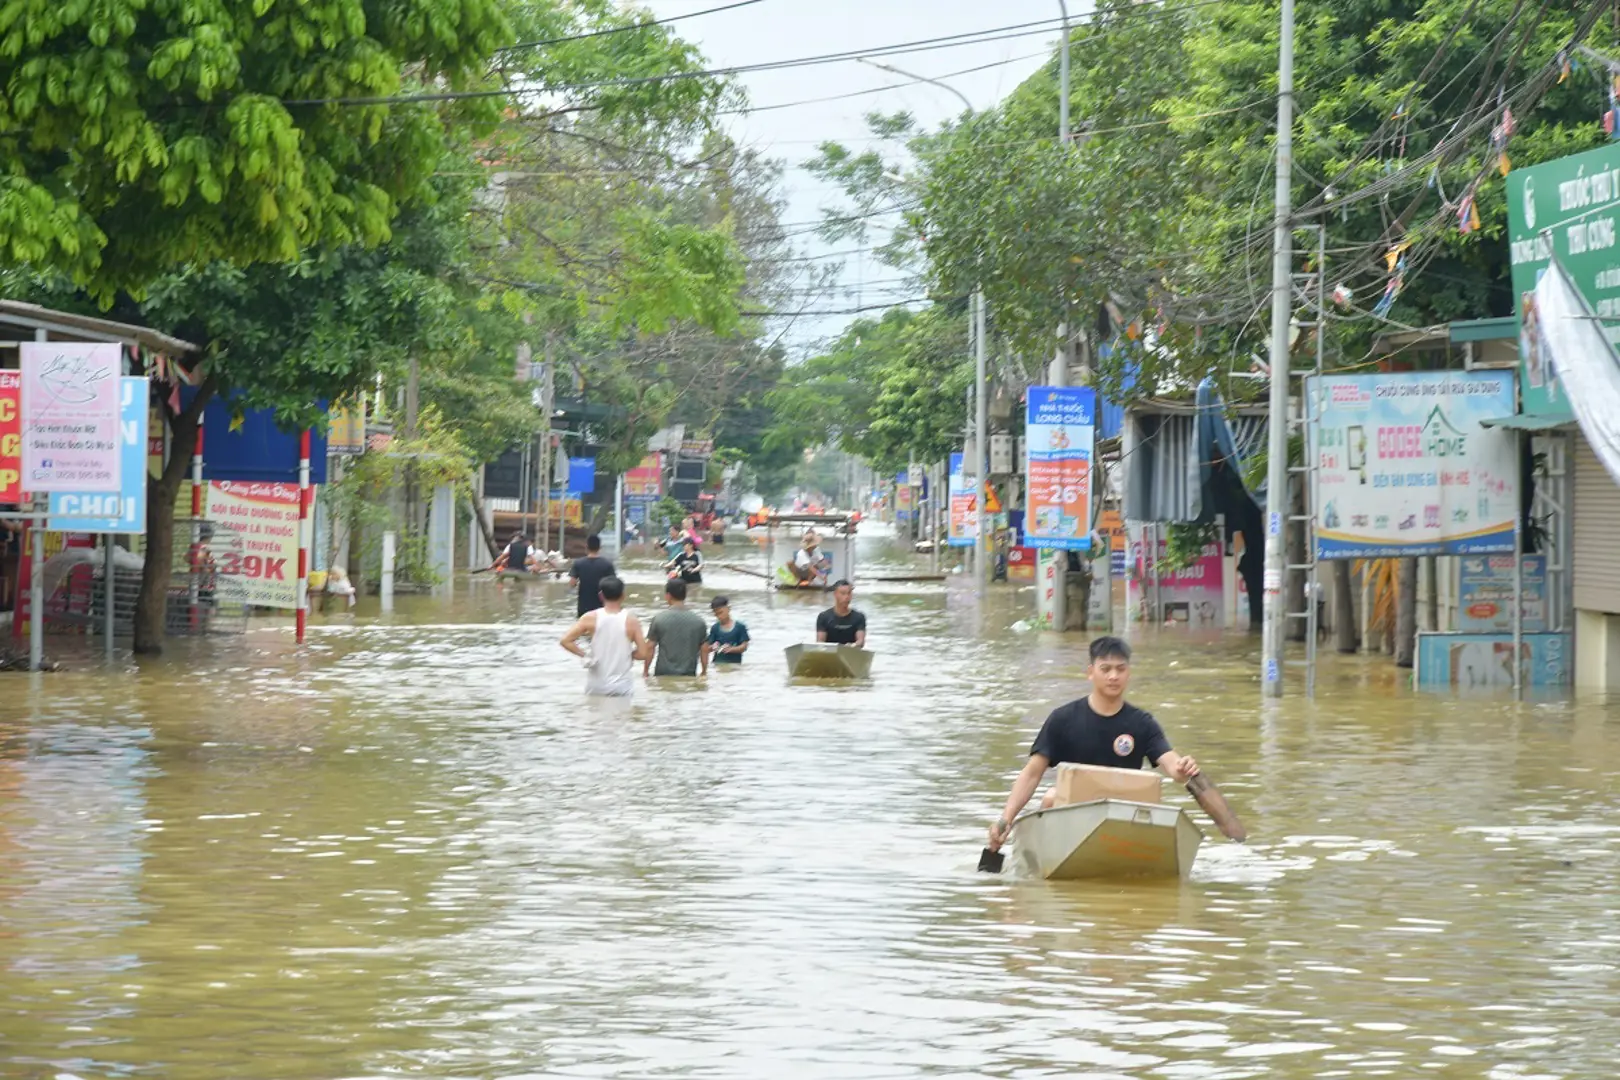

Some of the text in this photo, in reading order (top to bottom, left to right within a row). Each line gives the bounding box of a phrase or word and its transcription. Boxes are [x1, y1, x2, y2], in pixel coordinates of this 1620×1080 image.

[1559, 164, 1591, 211] THUỐC
[1591, 163, 1611, 205] THÚ
[1428, 437, 1467, 458] HOME
[58, 493, 136, 528] CHỌI
